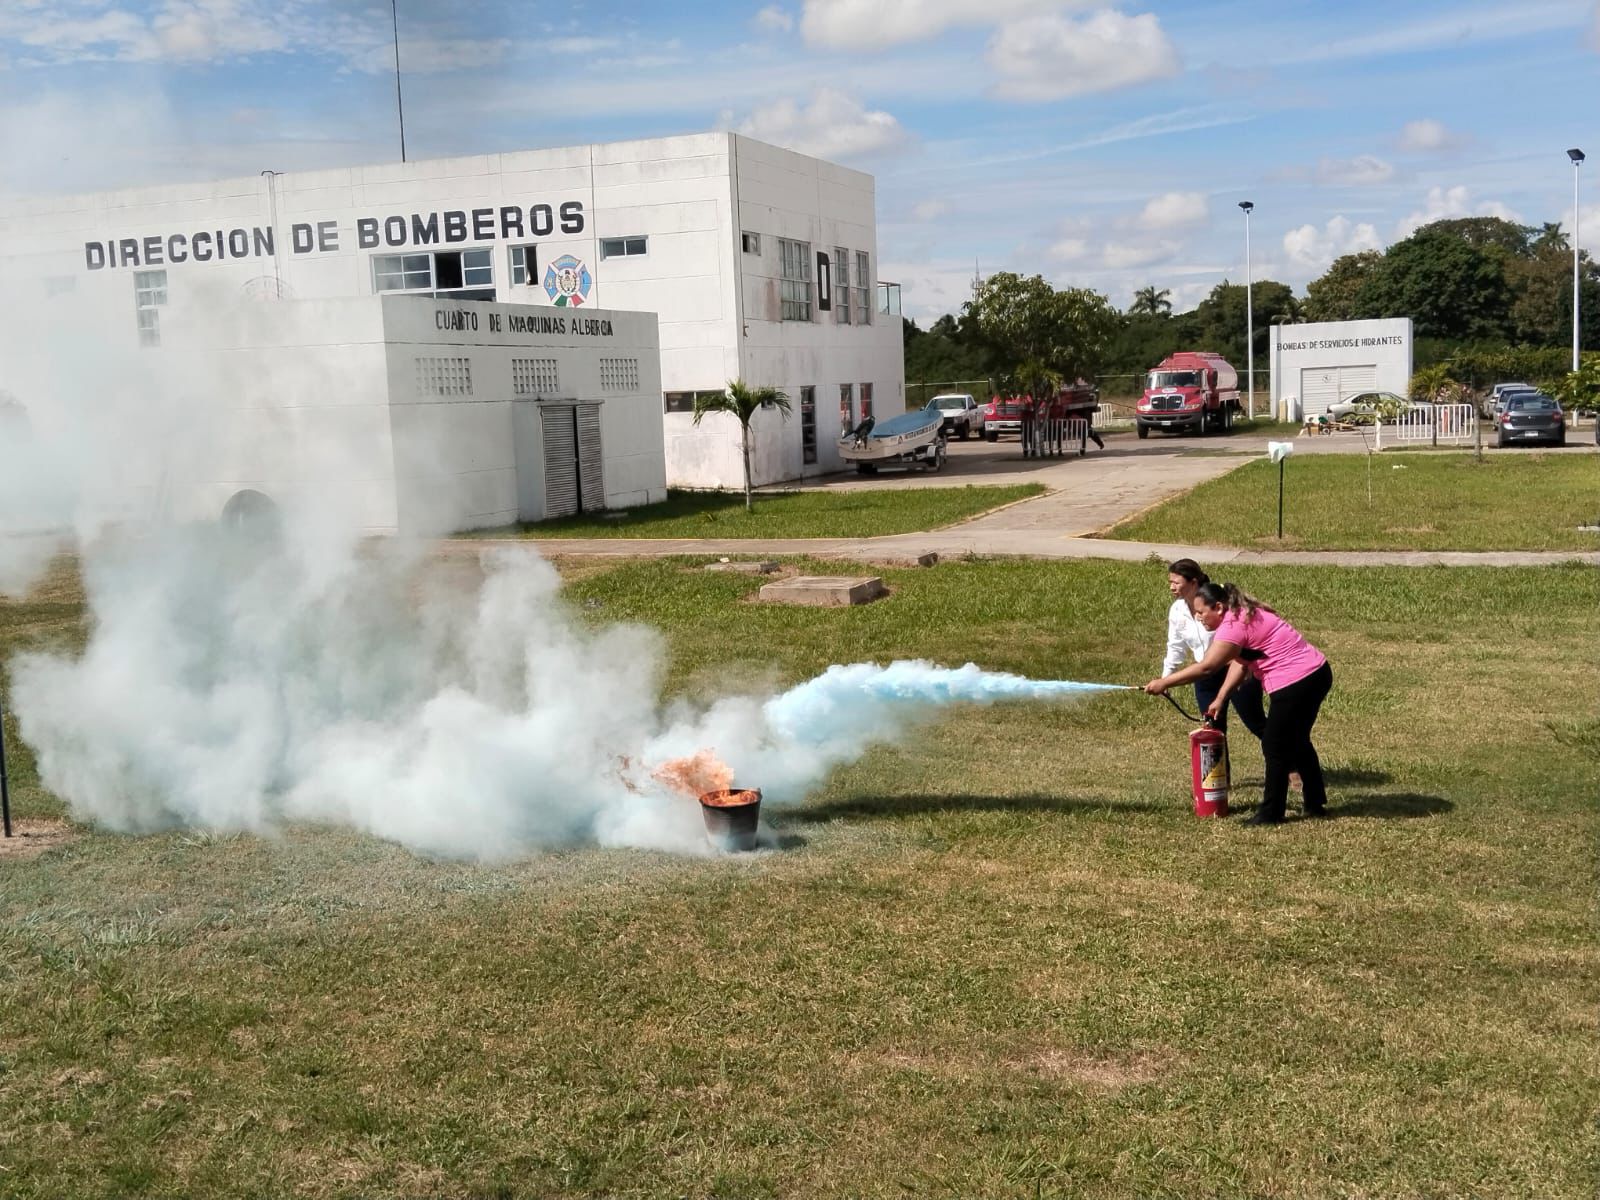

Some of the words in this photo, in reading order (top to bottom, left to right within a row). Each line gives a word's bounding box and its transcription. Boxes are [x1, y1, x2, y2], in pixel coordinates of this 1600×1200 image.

[85, 226, 275, 271] DIRECCION
[293, 221, 339, 254] DE
[358, 201, 584, 249] BOMBEROS
[435, 309, 479, 331] CUARTO
[489, 313, 502, 333] DE
[509, 315, 566, 335] MAQUINAS
[571, 318, 613, 336] ALBERCA
[1277, 341, 1306, 351] BOMBAS
[1309, 340, 1317, 349] DE
[1320, 338, 1354, 349] SERVICIOS
[1361, 336, 1402, 347] HIDRANTES
